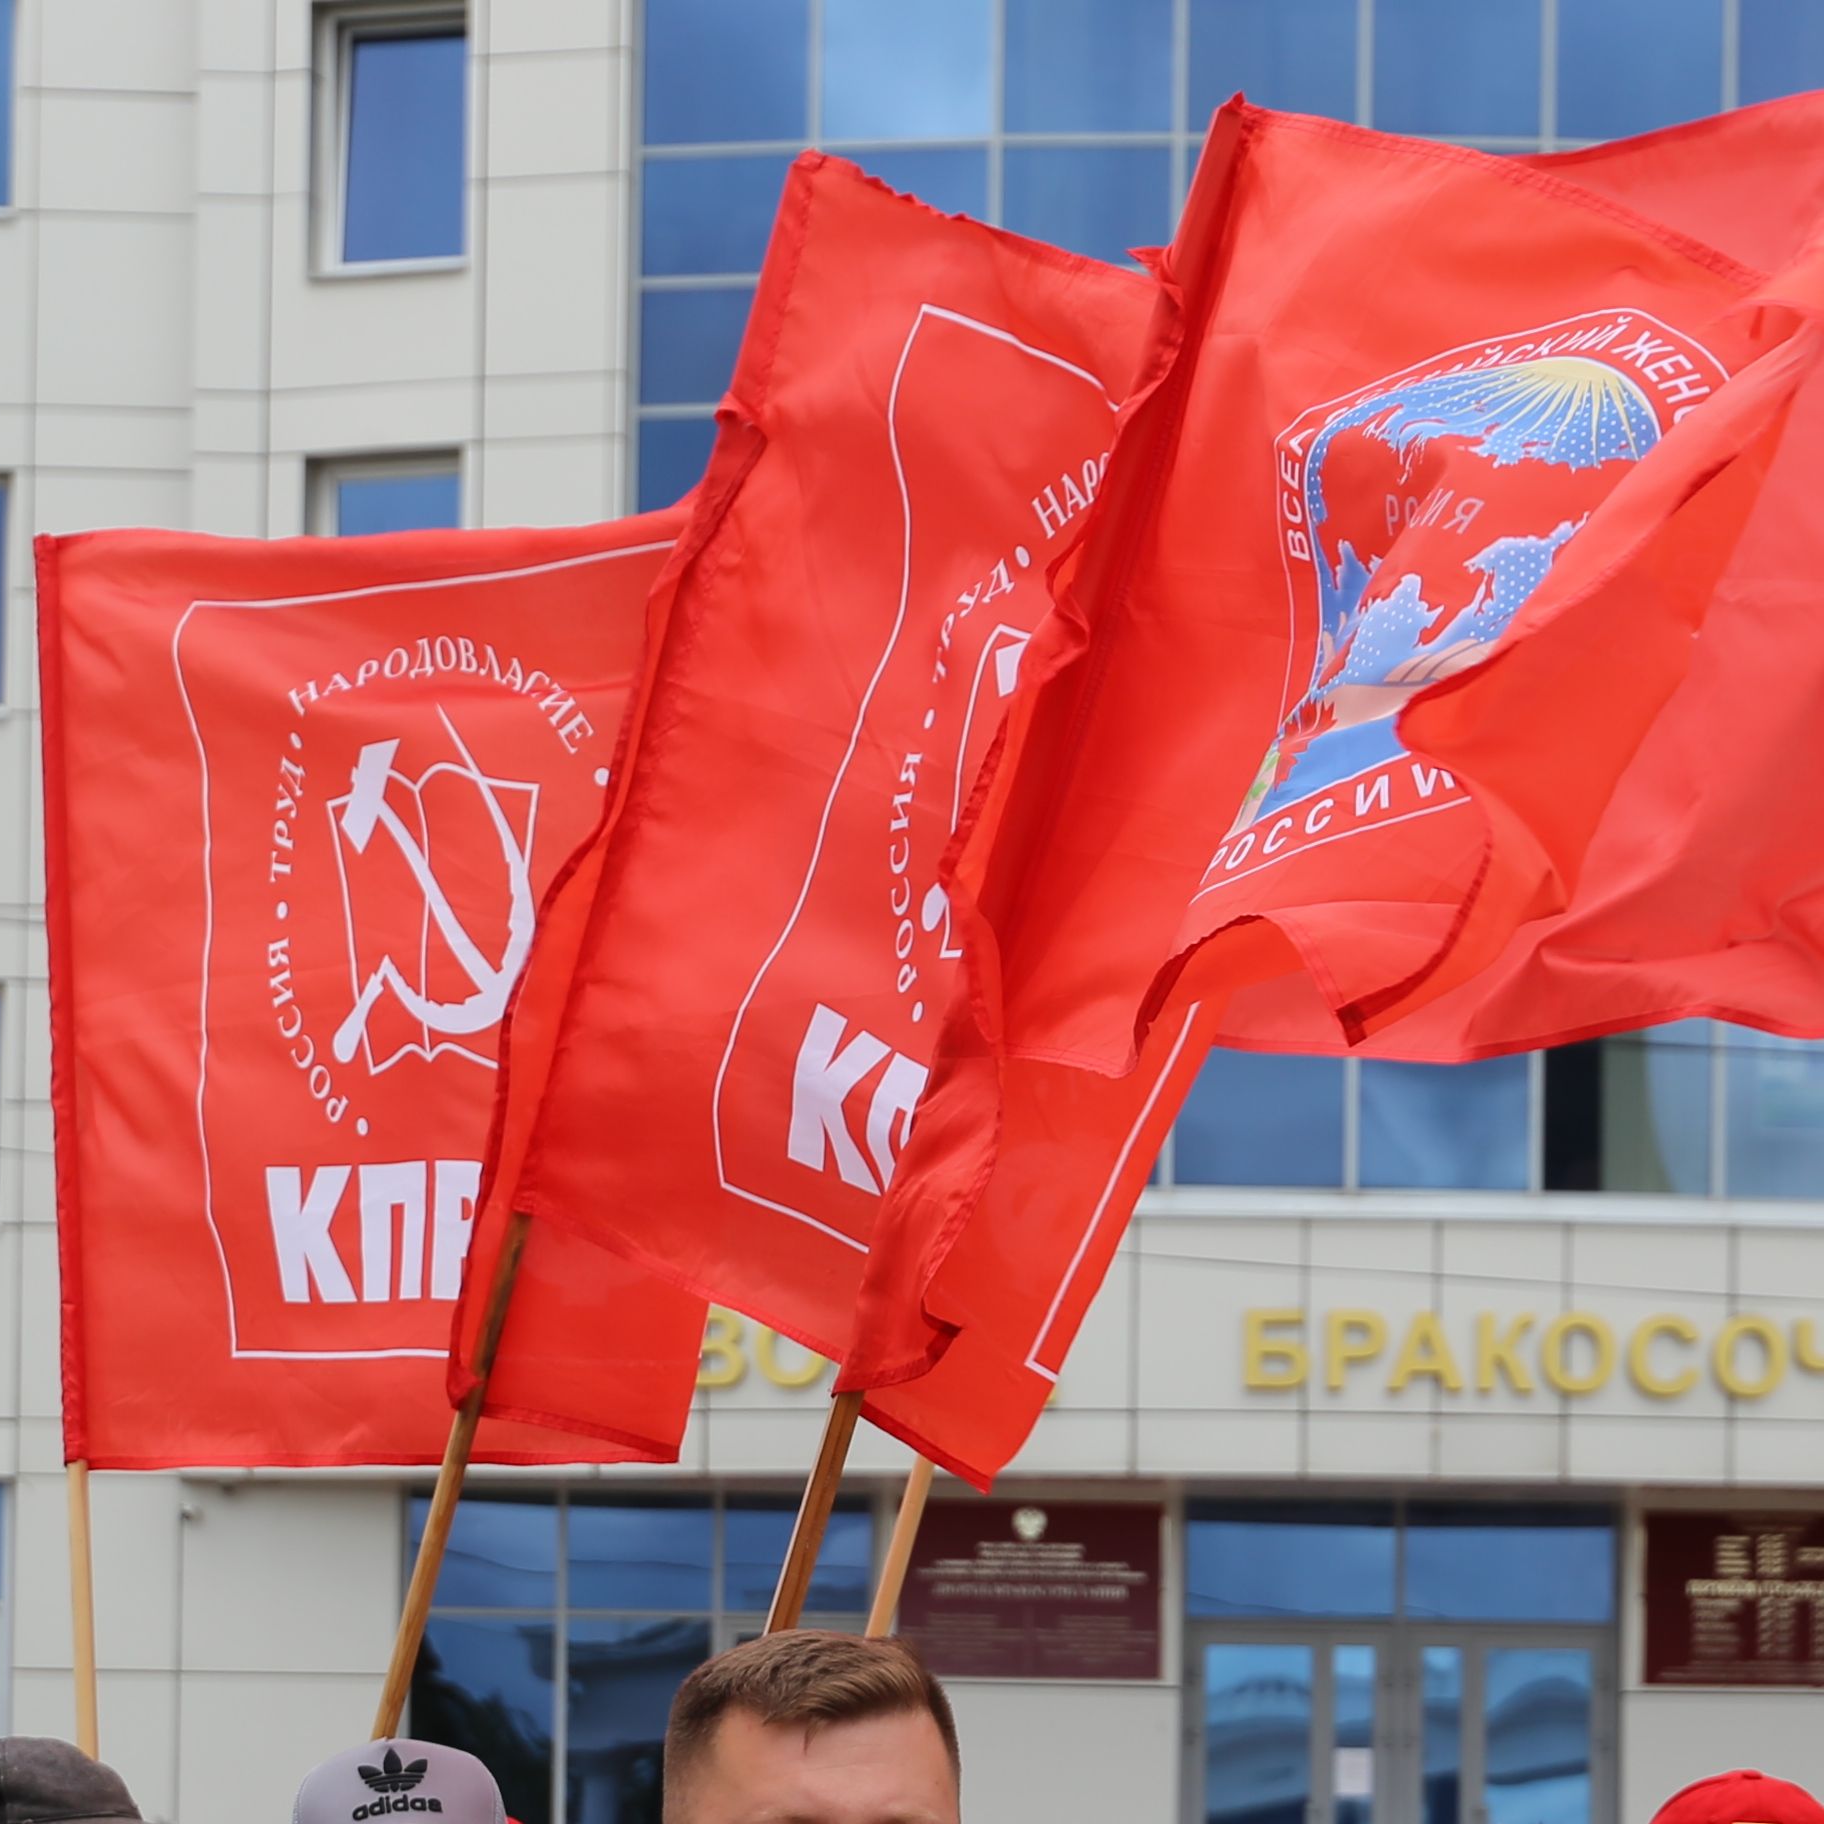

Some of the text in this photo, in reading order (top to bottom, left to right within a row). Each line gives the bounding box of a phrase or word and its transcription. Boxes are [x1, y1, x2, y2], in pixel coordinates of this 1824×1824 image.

[931, 557, 1016, 685] ТРУД
[287, 636, 595, 754] НАРОДОВЛАСИЕ
[269, 756, 307, 884] ТРУД
[890, 751, 925, 996] РОССИЯ
[1199, 763, 1456, 886] РОССИИ
[269, 936, 350, 1123] РОССИЯ
[265, 1159, 484, 1304] КПР
[352, 1793, 444, 1821] adidas
